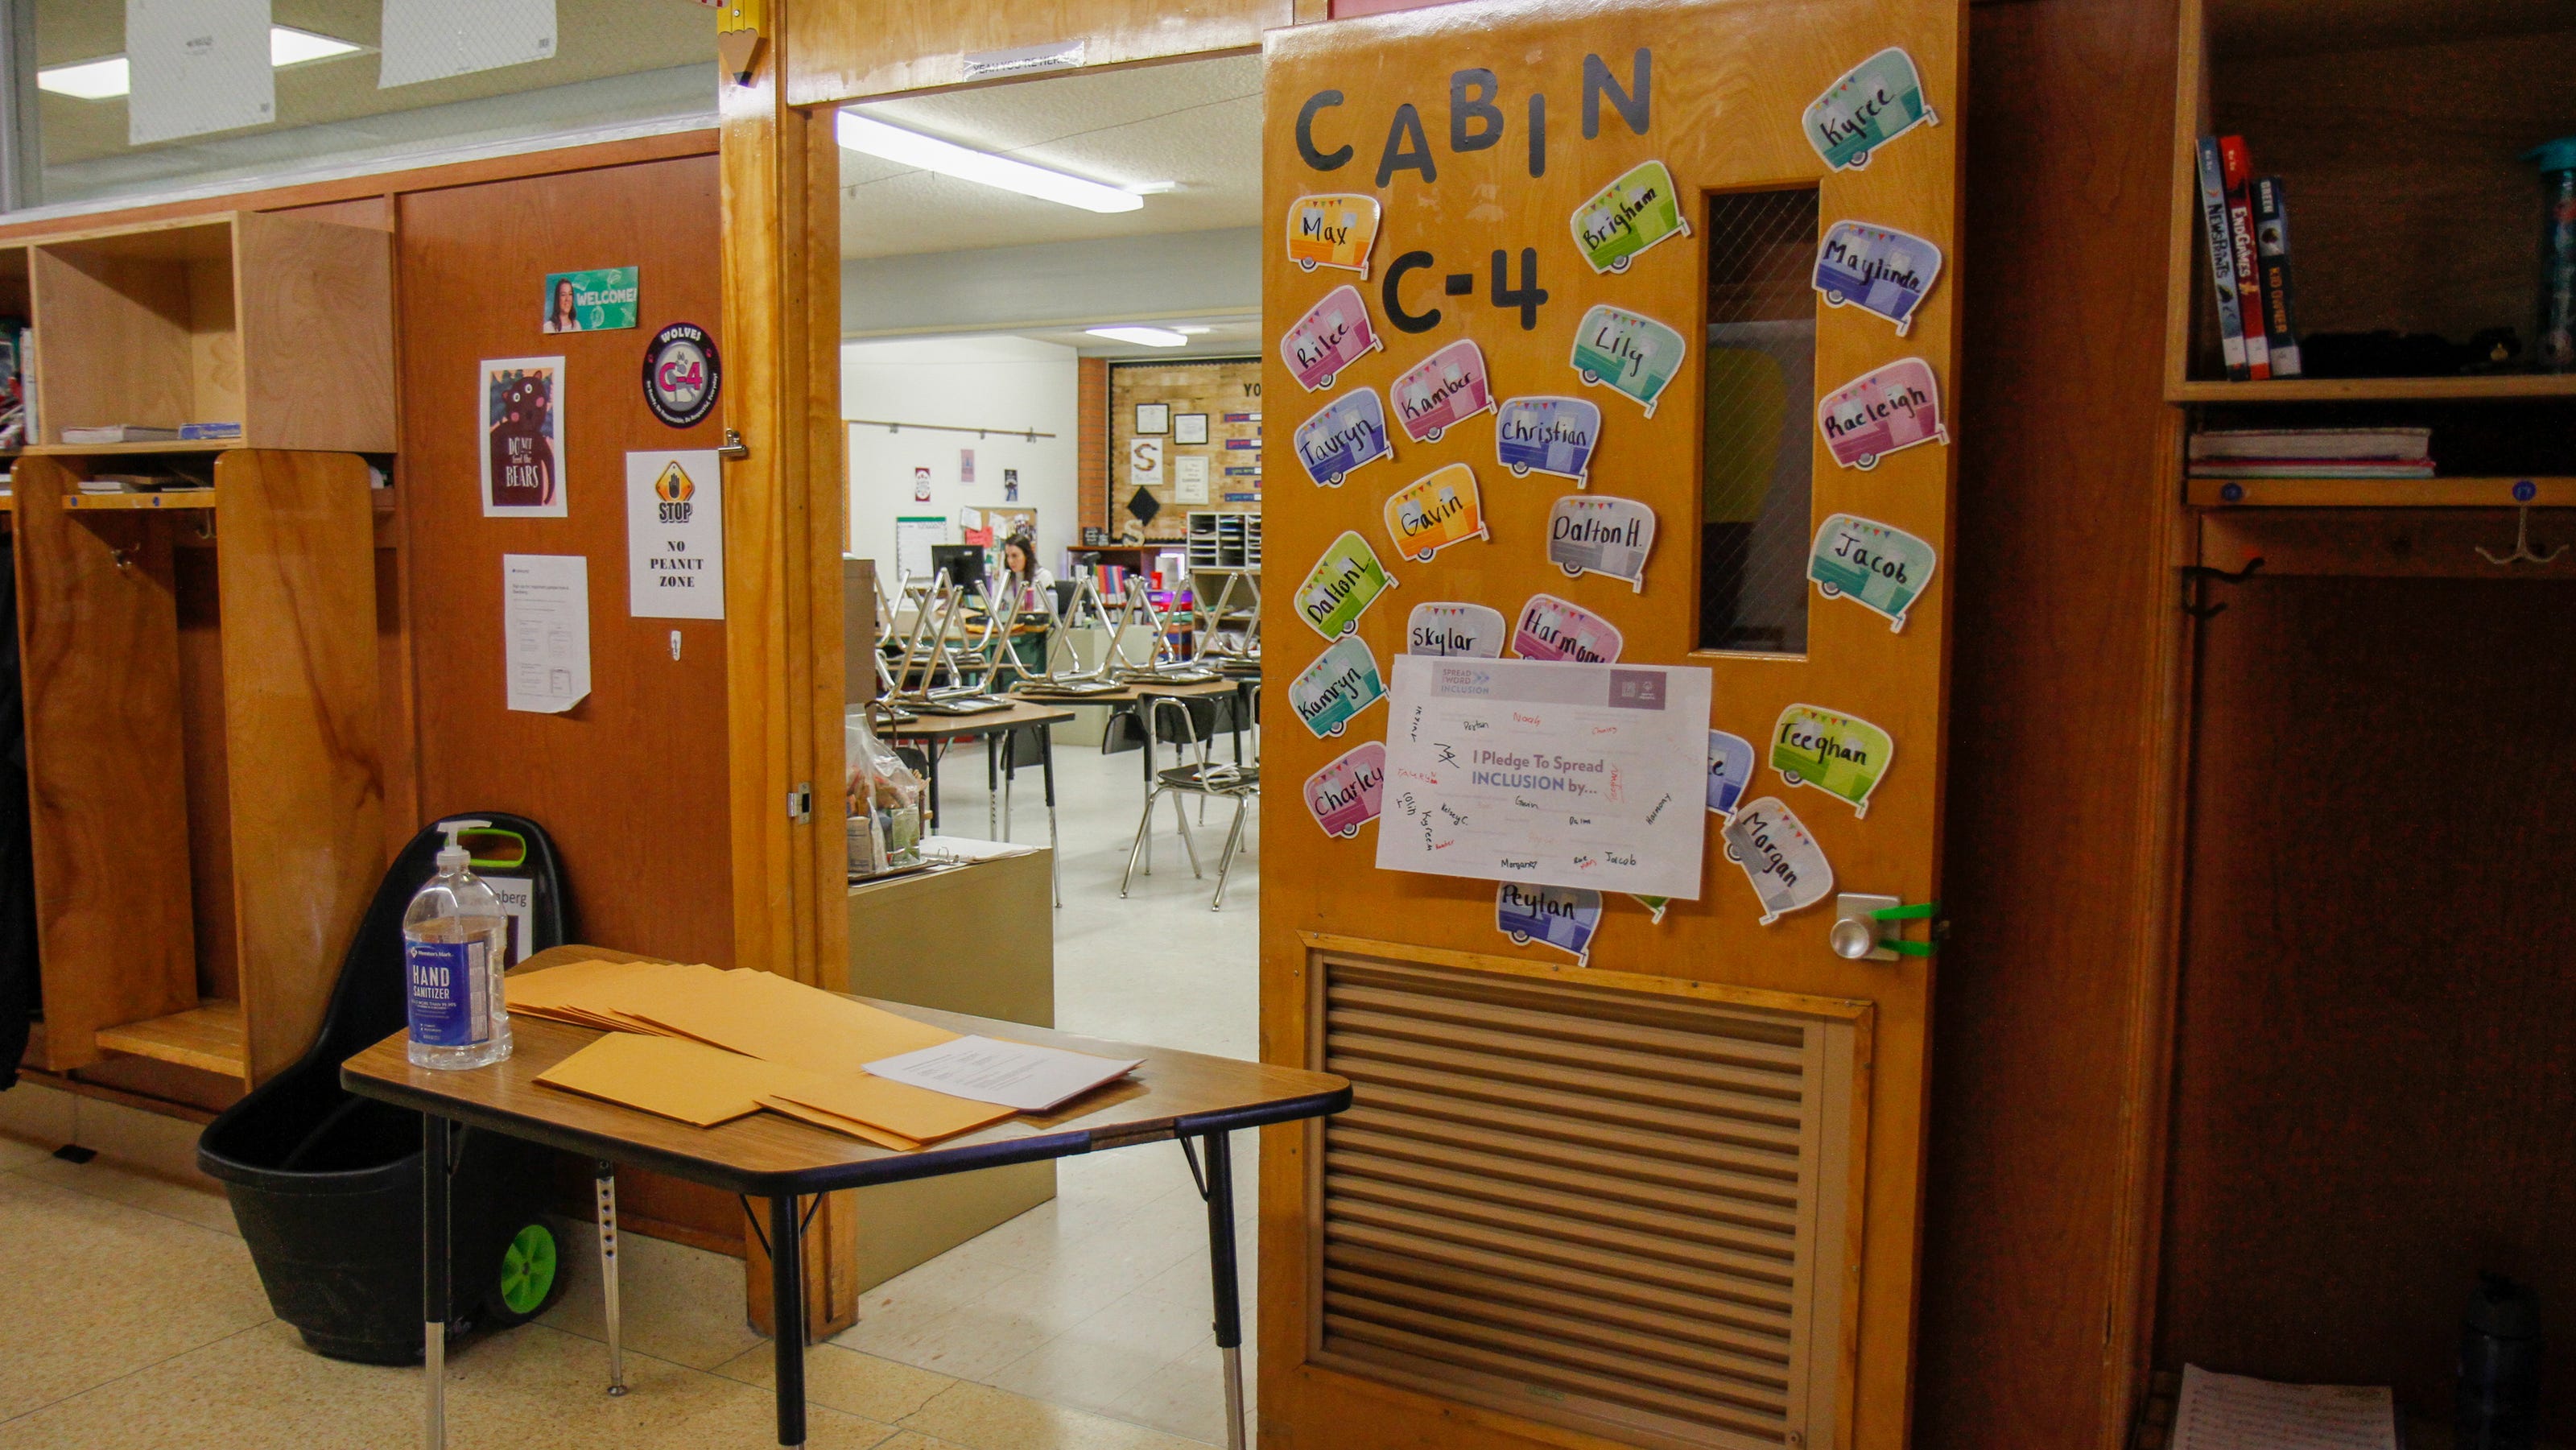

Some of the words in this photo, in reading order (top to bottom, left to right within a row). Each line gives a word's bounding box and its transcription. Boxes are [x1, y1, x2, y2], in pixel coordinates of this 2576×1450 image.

[1295, 47, 1652, 188] CABIN
[1819, 89, 1895, 147] Kyree
[1302, 217, 1348, 246] Max
[1583, 188, 1657, 251] Brigham
[1823, 239, 1922, 293] Maylinda
[576, 287, 638, 307] WELCOME!
[1381, 246, 1549, 334] C-4
[660, 327, 701, 343] WOLVES
[1296, 322, 1349, 370] Rilee
[1596, 326, 1644, 378] Lily
[658, 361, 703, 392] C-4
[1401, 372, 1472, 419] Kamber
[1825, 386, 1927, 439] Raeleigh
[508, 437, 520, 456] DO
[1502, 420, 1587, 447] Christian
[506, 465, 539, 488] BEARS
[658, 501, 693, 523] STOP
[1401, 495, 1463, 537] Gavin
[1552, 516, 1621, 544] Dalton
[667, 541, 686, 552] NO
[1835, 532, 1908, 584] Jacob
[650, 558, 704, 570] PEANUT
[659, 576, 695, 588] ZONE
[1307, 570, 1360, 624] Dalton
[1413, 627, 1477, 656] Skylar
[1443, 668, 1472, 677] SPREAD
[1298, 667, 1362, 721] Kamryn
[1441, 685, 1489, 695] INCLUSION
[1780, 723, 1867, 766] Teeghan
[1473, 750, 1477, 762] I
[1482, 750, 1530, 770] Pledge
[1534, 754, 1550, 769] To
[1554, 756, 1604, 774] Spread
[1315, 766, 1385, 816] Charley
[1472, 771, 1564, 791] INCLUSION
[1569, 778, 1597, 795] by...
[1605, 851, 1637, 866] Jacob
[1742, 812, 1798, 887] Morgan
[412, 965, 450, 987] HAND
[413, 985, 450, 999] SANITIZER
